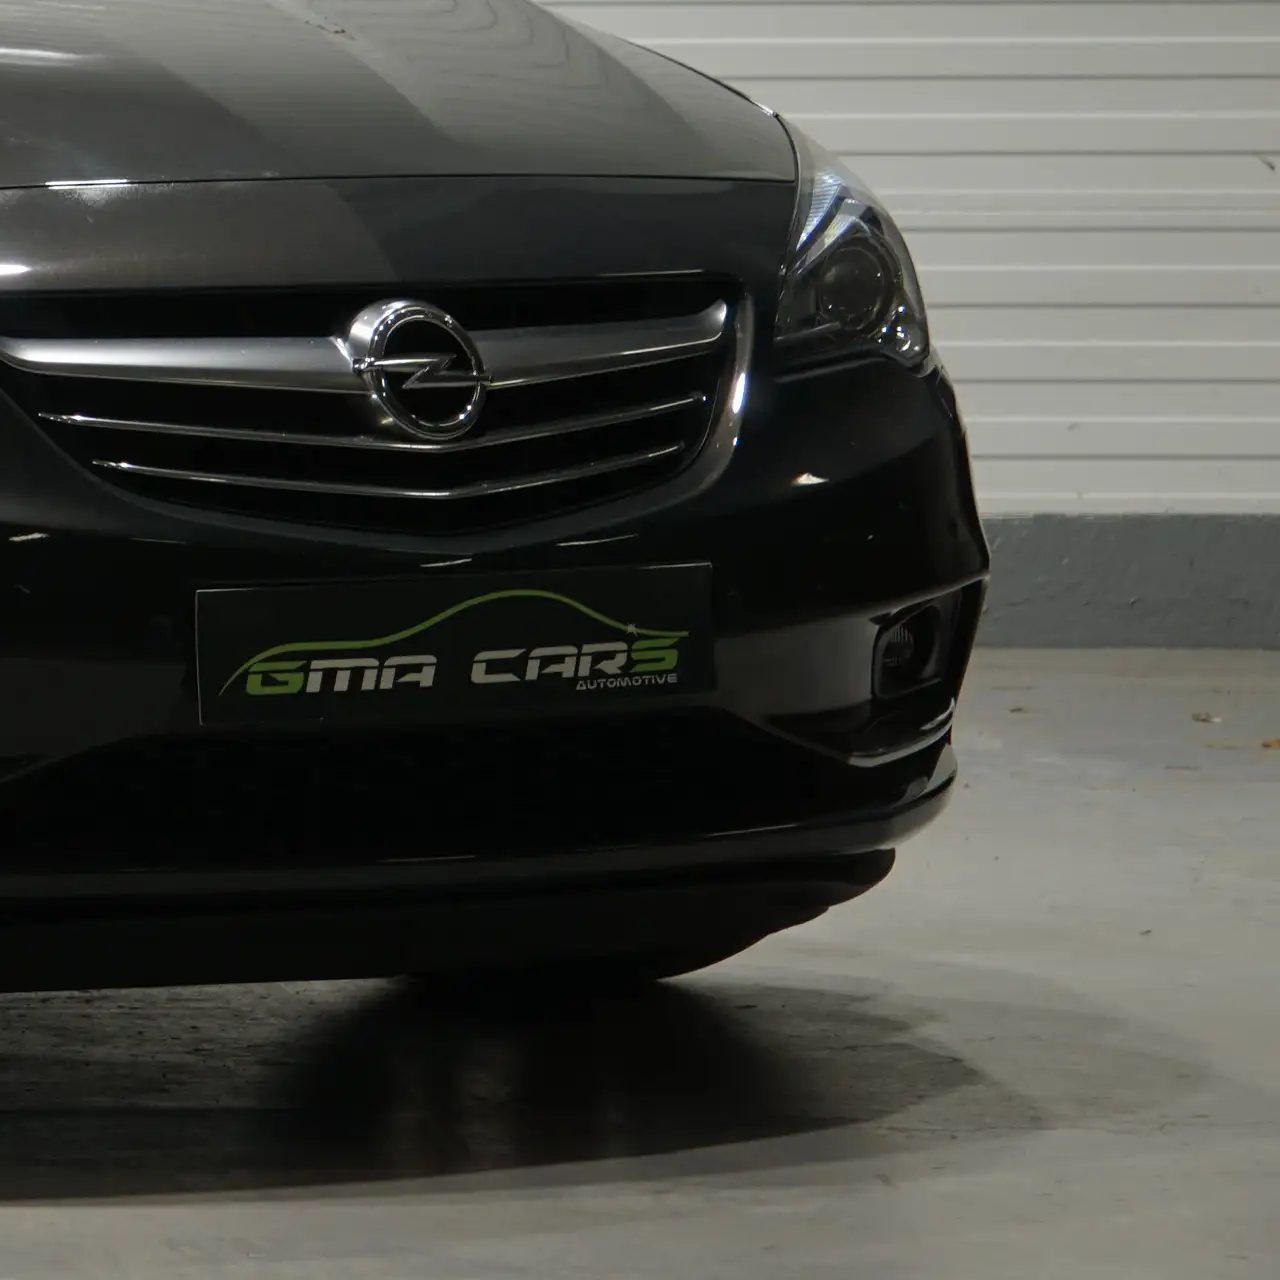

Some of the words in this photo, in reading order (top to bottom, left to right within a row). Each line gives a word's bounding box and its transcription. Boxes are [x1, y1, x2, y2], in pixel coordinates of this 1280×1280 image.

[246, 656, 437, 695] GMA
[470, 638, 679, 684] CARS
[575, 673, 678, 691] AUTOMOTIVE
